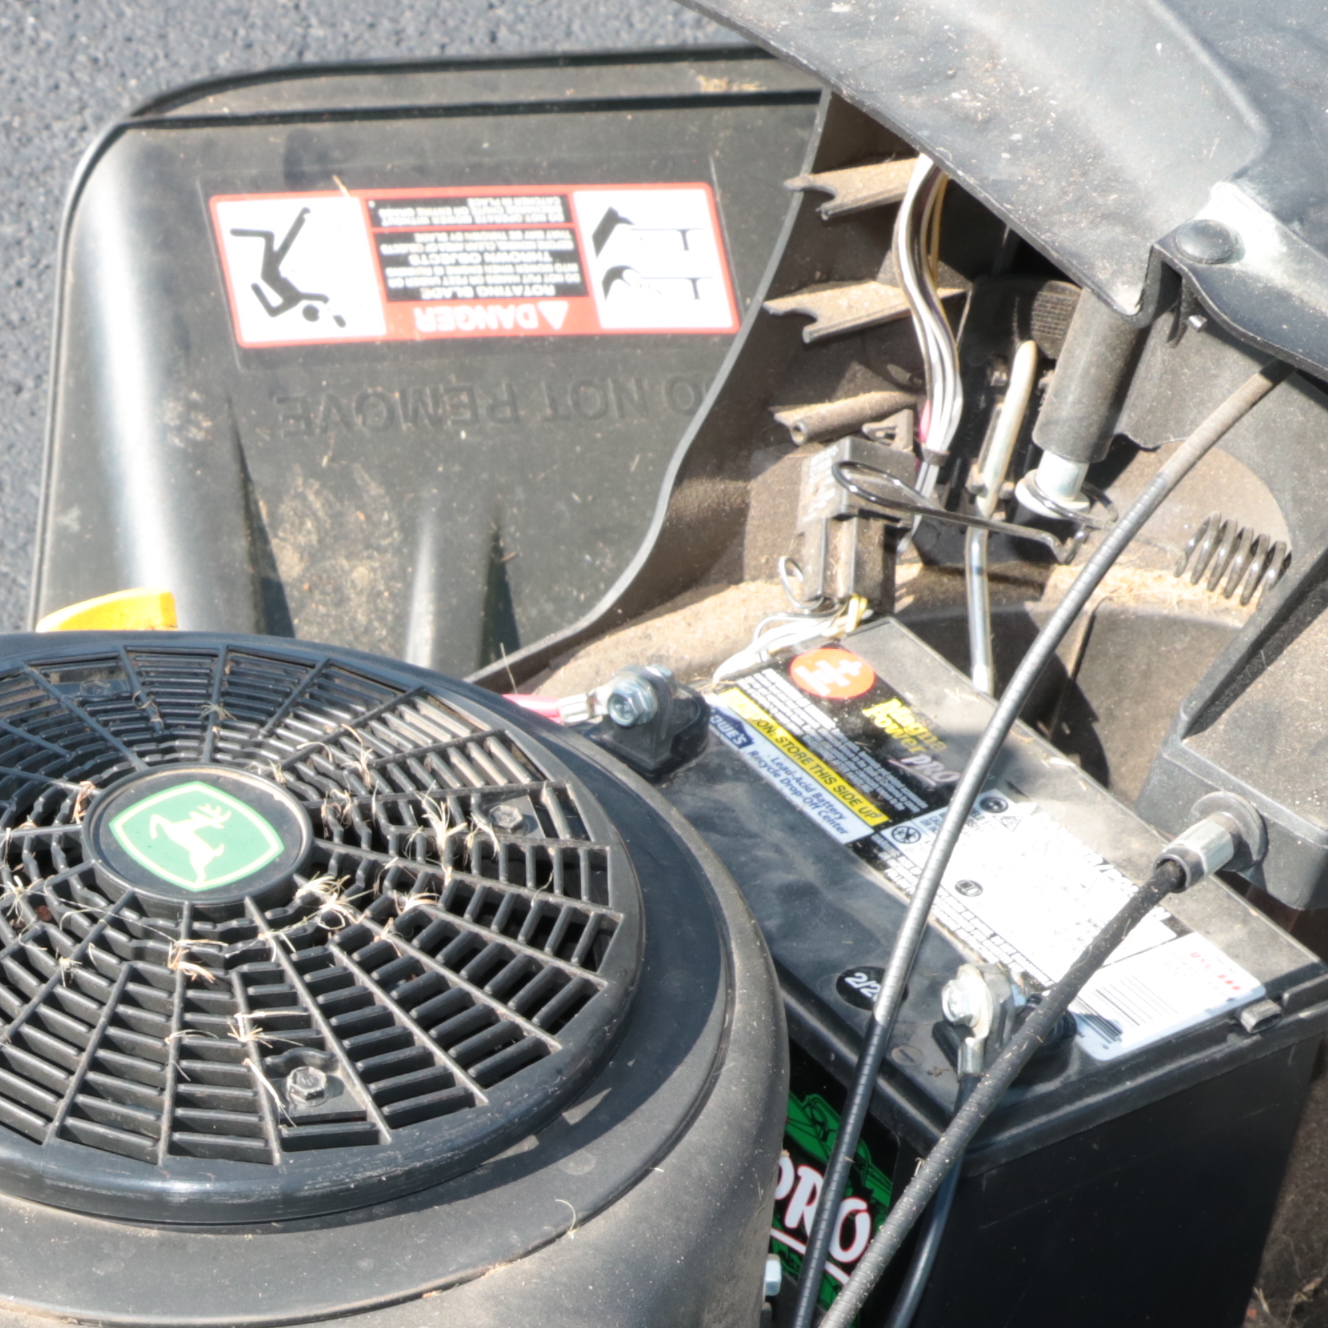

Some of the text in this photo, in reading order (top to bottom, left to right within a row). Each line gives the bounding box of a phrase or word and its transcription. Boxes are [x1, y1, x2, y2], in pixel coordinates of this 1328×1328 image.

[407, 250, 552, 265] THROWN OBJECTS
[419, 284, 556, 298] ROTATING BLADE
[412, 303, 538, 330] DANGER
[271, 382, 520, 438] REMOVE
[542, 375, 649, 422] NOT
[861, 705, 926, 753] Power
[877, 699, 950, 751] Magna
[769, 756, 816, 794] Lead-Acid
[809, 792, 847, 822] Battery
[774, 733, 813, 766] STORE
[808, 762, 837, 786] THIS
[831, 782, 862, 807] SIDE
[857, 804, 879, 821] UP
[899, 750, 960, 784] PRO
[747, 748, 850, 835] Recycle Drop-Off Center
